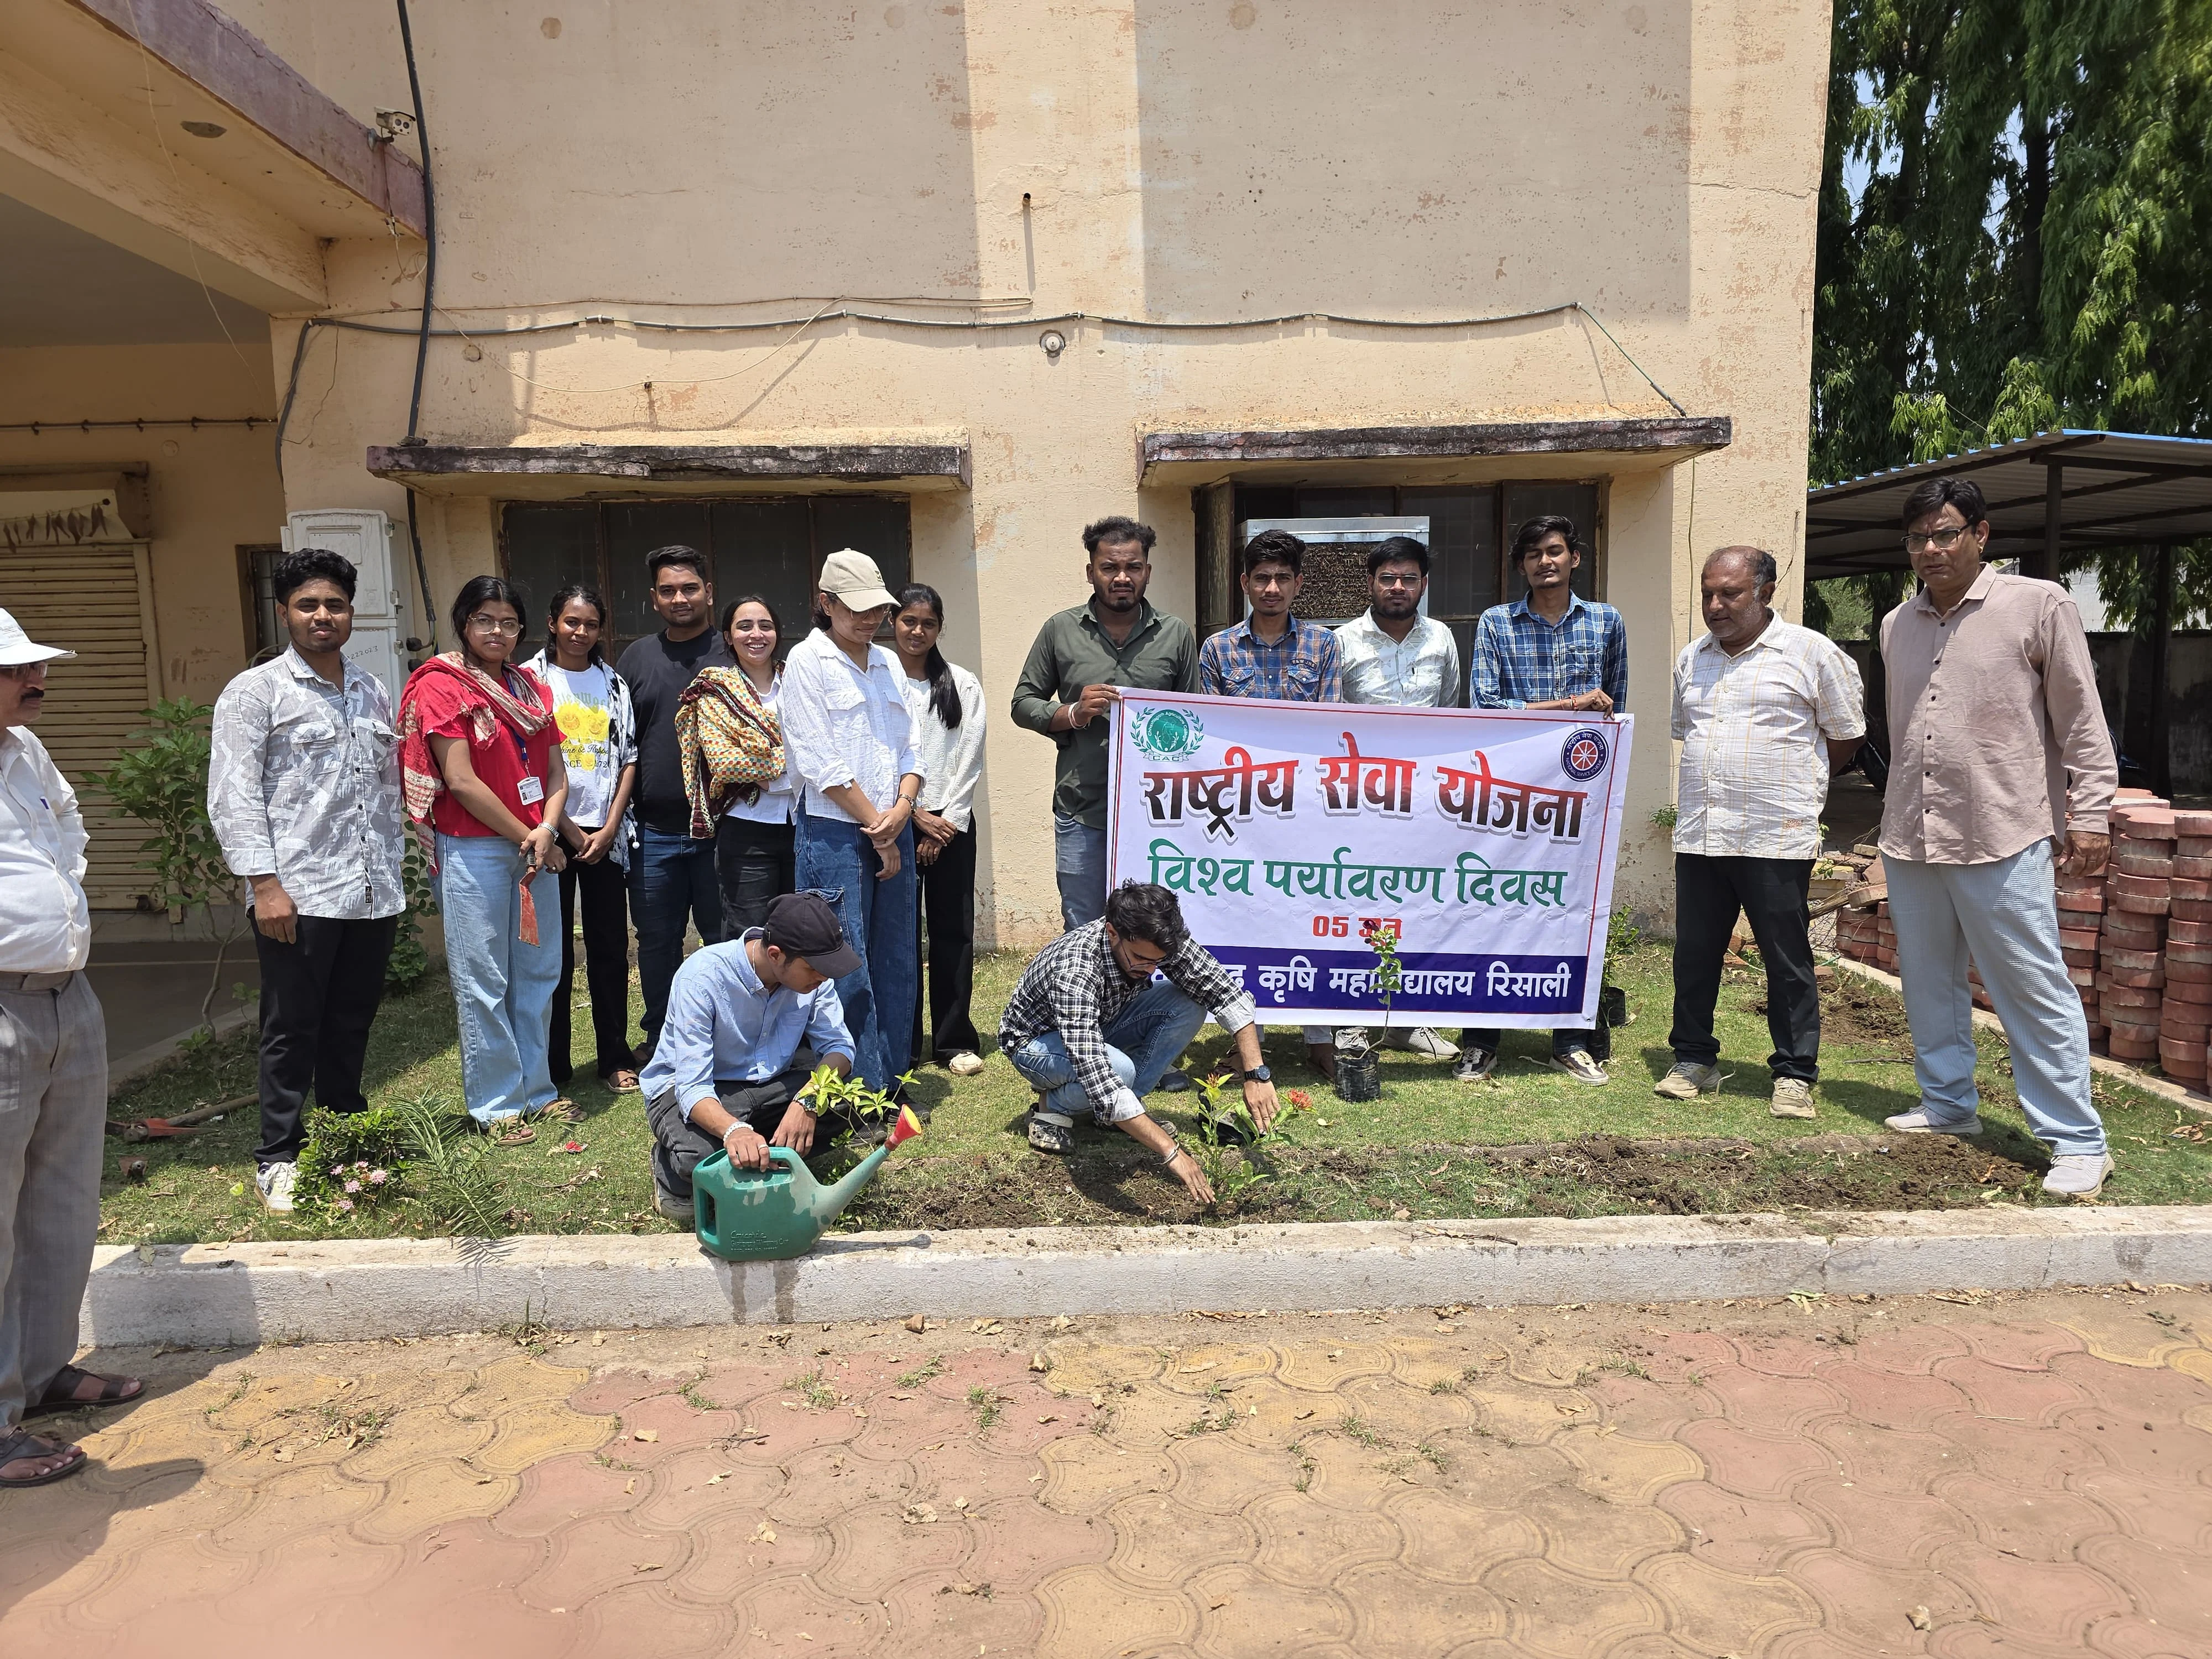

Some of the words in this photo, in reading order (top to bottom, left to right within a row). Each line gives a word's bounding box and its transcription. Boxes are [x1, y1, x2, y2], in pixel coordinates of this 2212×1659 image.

[561, 744, 577, 754] hine
[564, 760, 582, 768] NCE
[1143, 746, 1300, 838] राष्ट्रीय
[1319, 731, 1417, 813] सेवा
[1437, 750, 1588, 838] योजना
[1147, 838, 1255, 896] विश्व
[1263, 846, 1446, 904] पर्यावरण
[1454, 851, 1568, 907] दिवस
[1313, 915, 1349, 937] 05
[1258, 955, 1318, 1003] कृषि
[1486, 961, 1572, 998] रिसाली
